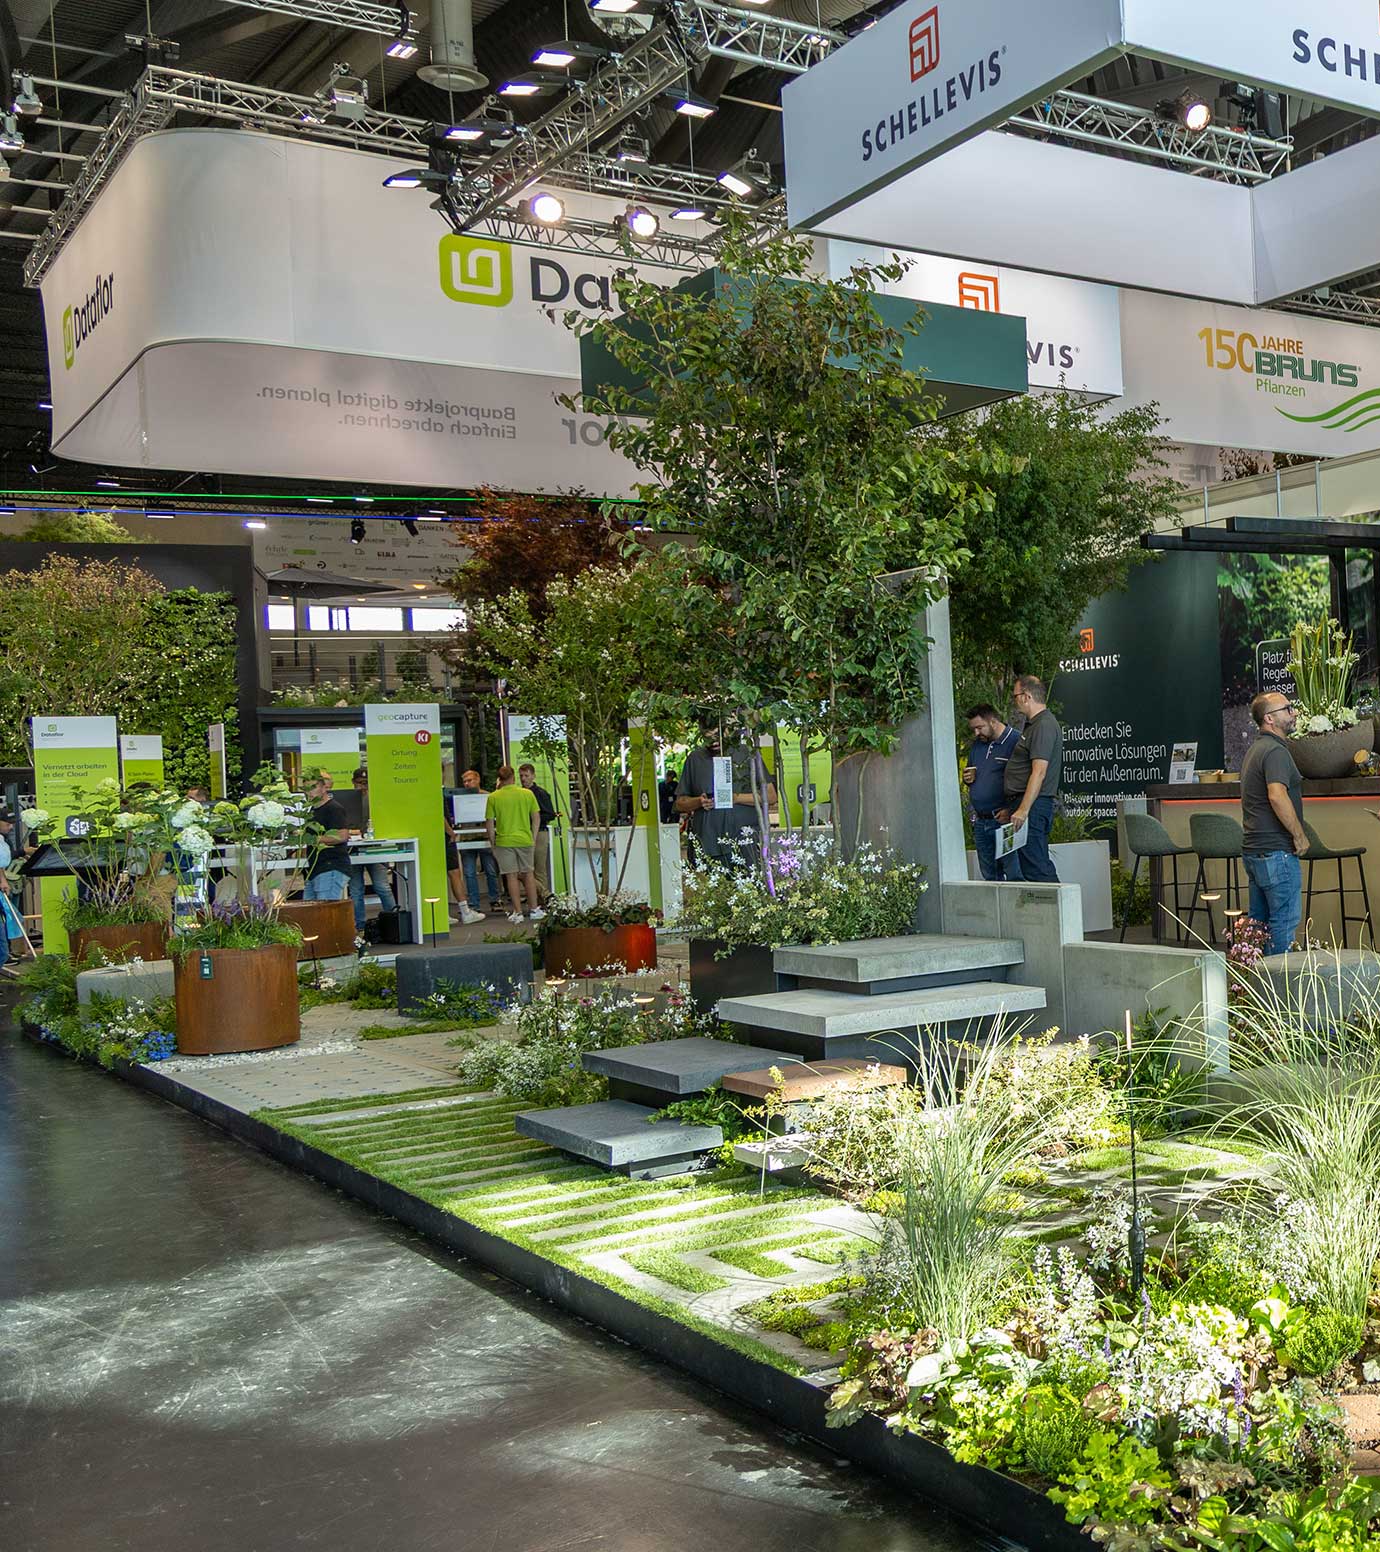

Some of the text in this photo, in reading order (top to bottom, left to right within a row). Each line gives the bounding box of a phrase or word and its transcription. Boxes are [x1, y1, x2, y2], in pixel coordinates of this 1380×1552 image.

[74, 272, 114, 349] Dataflor
[1198, 327, 1258, 373] 150
[1260, 335, 1304, 355] JAHRE
[1256, 378, 1306, 397] Pflanzen
[377, 712, 429, 722] geocapture
[417, 733, 429, 742] KI
[1061, 721, 1132, 741] Entdecken Sie
[1062, 743, 1167, 763] innovative Lösungen
[1063, 764, 1164, 783] für den Außenraum.
[1094, 807, 1118, 819] spaces
